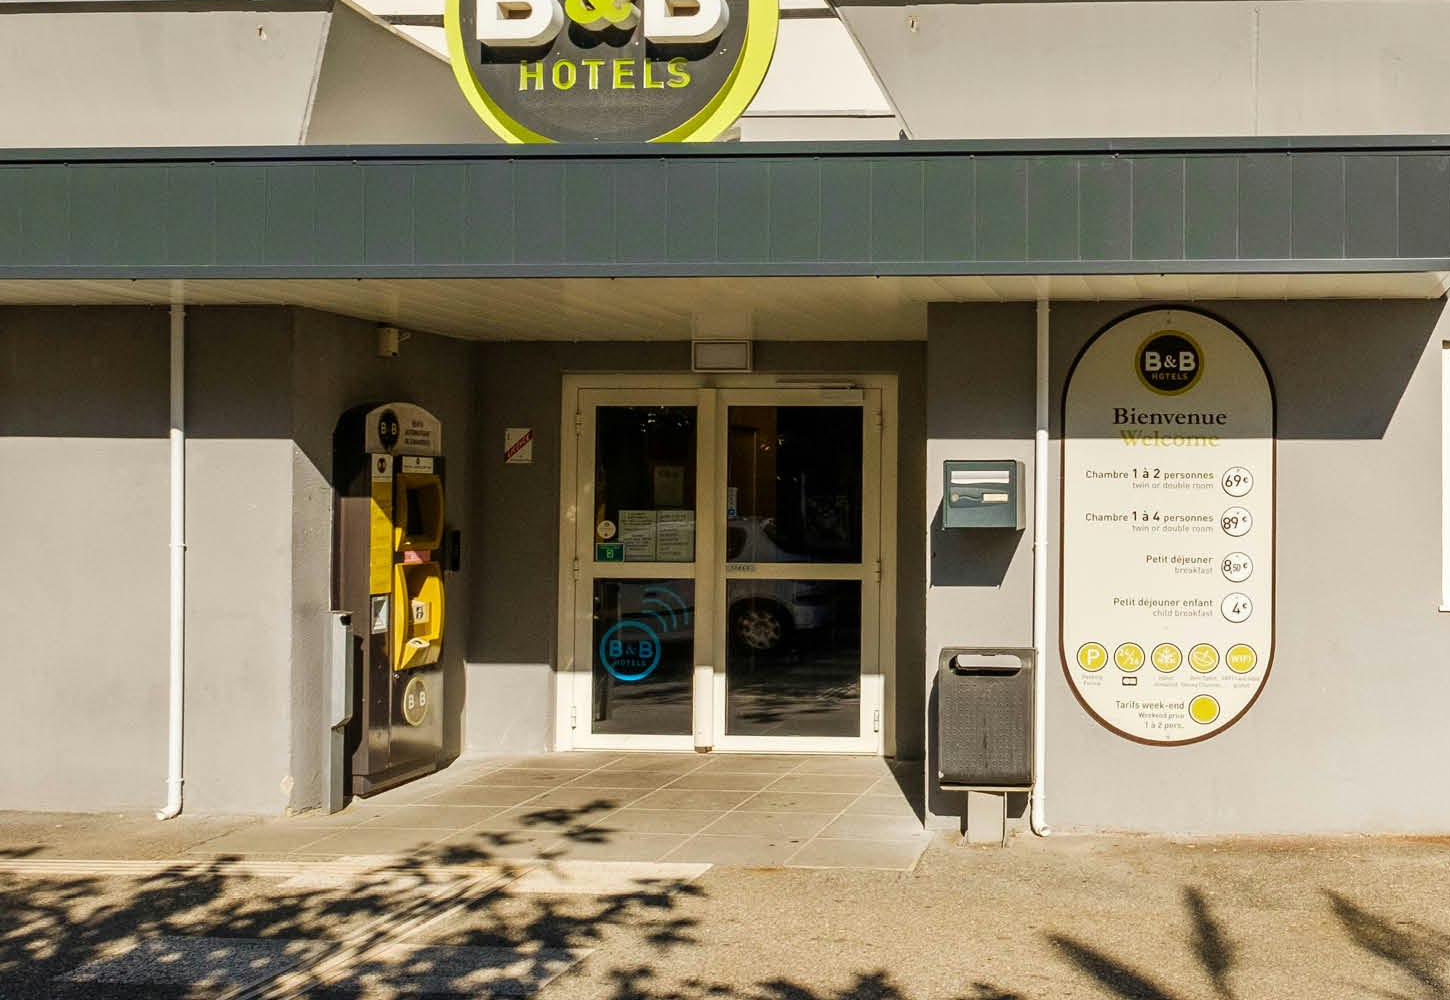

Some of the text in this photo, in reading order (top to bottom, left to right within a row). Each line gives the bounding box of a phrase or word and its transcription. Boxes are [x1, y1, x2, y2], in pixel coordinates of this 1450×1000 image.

[518, 57, 692, 91] HOTELS
[1144, 351, 1197, 372] B&B
[1151, 372, 1189, 381] HOTELS
[1112, 407, 1228, 425] Bienvenue
[380, 421, 398, 436] BB
[1119, 429, 1221, 448] Welcome
[1085, 467, 1215, 481] Chambre 1 à 2 personnes
[1162, 481, 1191, 489] double
[1085, 510, 1214, 524] Chambre 1 à 4 personnes
[1162, 524, 1191, 532] double
[1146, 555, 1168, 564] Petit
[1174, 566, 1213, 574] breakfast
[1113, 597, 1135, 607] Petit
[1182, 598, 1213, 607] enfant
[1152, 609, 1213, 617] child breakfast
[1087, 648, 1100, 666] P
[408, 690, 426, 710] BB
[1115, 700, 1185, 710] Tarifs week-end
